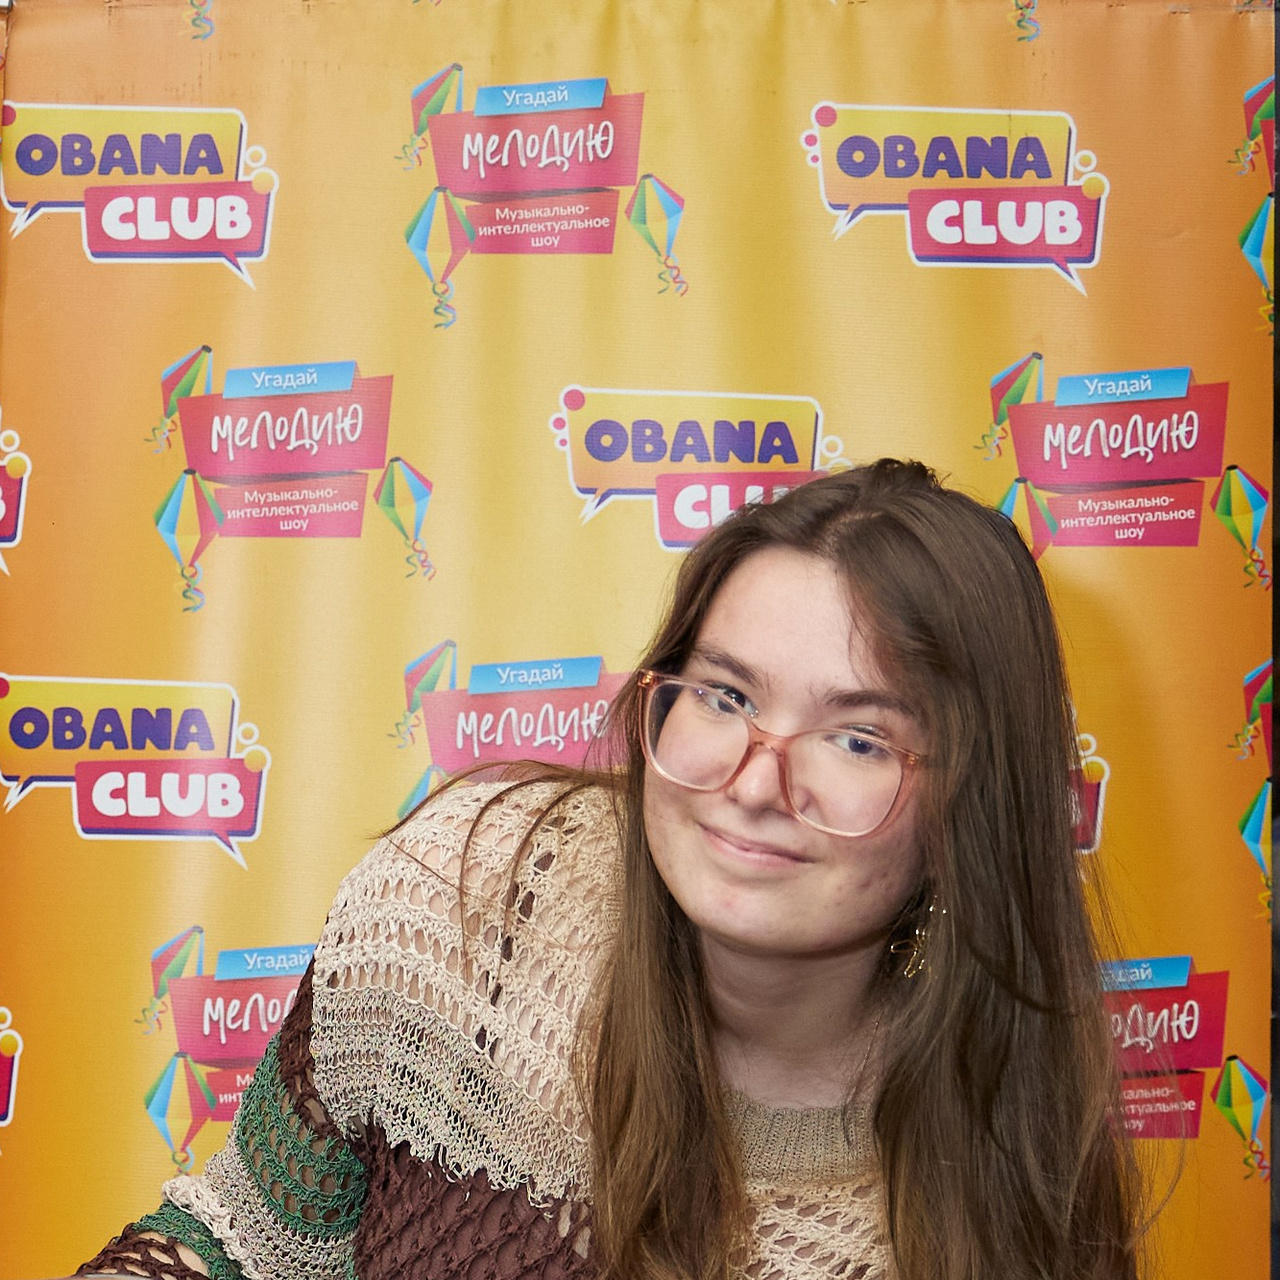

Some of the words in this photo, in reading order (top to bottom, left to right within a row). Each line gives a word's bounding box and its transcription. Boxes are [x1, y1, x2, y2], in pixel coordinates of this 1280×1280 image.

[503, 85, 569, 108] Угадай
[15, 132, 223, 177] OBANA
[836, 135, 1052, 180] OBANA
[101, 196, 252, 241] CLUB
[495, 205, 590, 222] Музыкально-
[927, 200, 1082, 246] CLUB
[478, 215, 610, 237] интеллектуальное
[530, 233, 560, 248] шоу
[251, 367, 318, 391] Угадай
[1084, 375, 1152, 400] Угадай
[584, 419, 800, 465] OBANA
[243, 487, 339, 505] Музыкально-
[1078, 496, 1175, 516] Музыкально-
[226, 498, 359, 520] интеллектуальное
[1060, 507, 1196, 531] интеллектуальное
[279, 516, 309, 532] шоу
[1115, 526, 1145, 542] шоу
[497, 664, 564, 685] Угадай
[8, 707, 216, 752] OBANA
[91, 772, 244, 818] CLUB
[244, 950, 312, 972] Угадай
